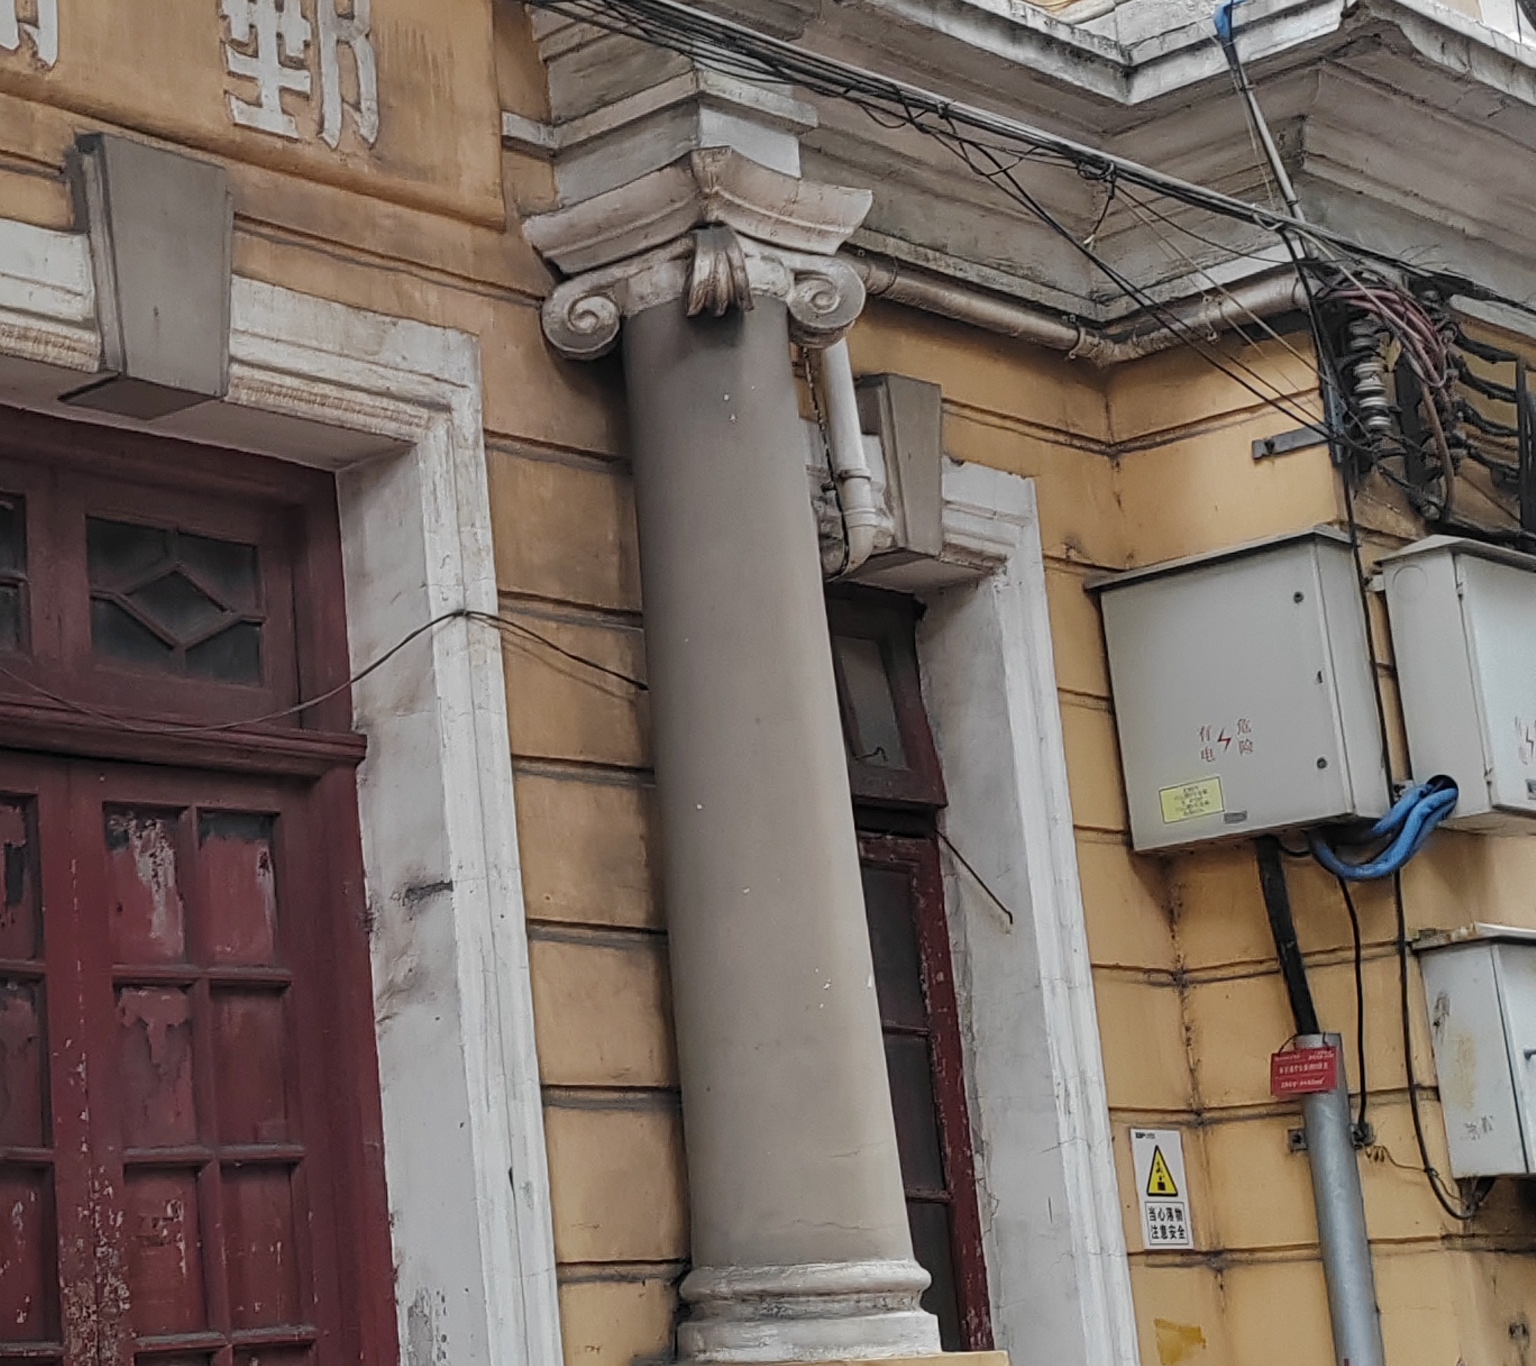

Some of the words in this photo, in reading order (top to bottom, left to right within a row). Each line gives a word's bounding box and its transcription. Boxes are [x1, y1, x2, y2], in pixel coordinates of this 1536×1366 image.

[1148, 1205, 1184, 1222] 当心落物
[1150, 1224, 1187, 1240] 注意安全
